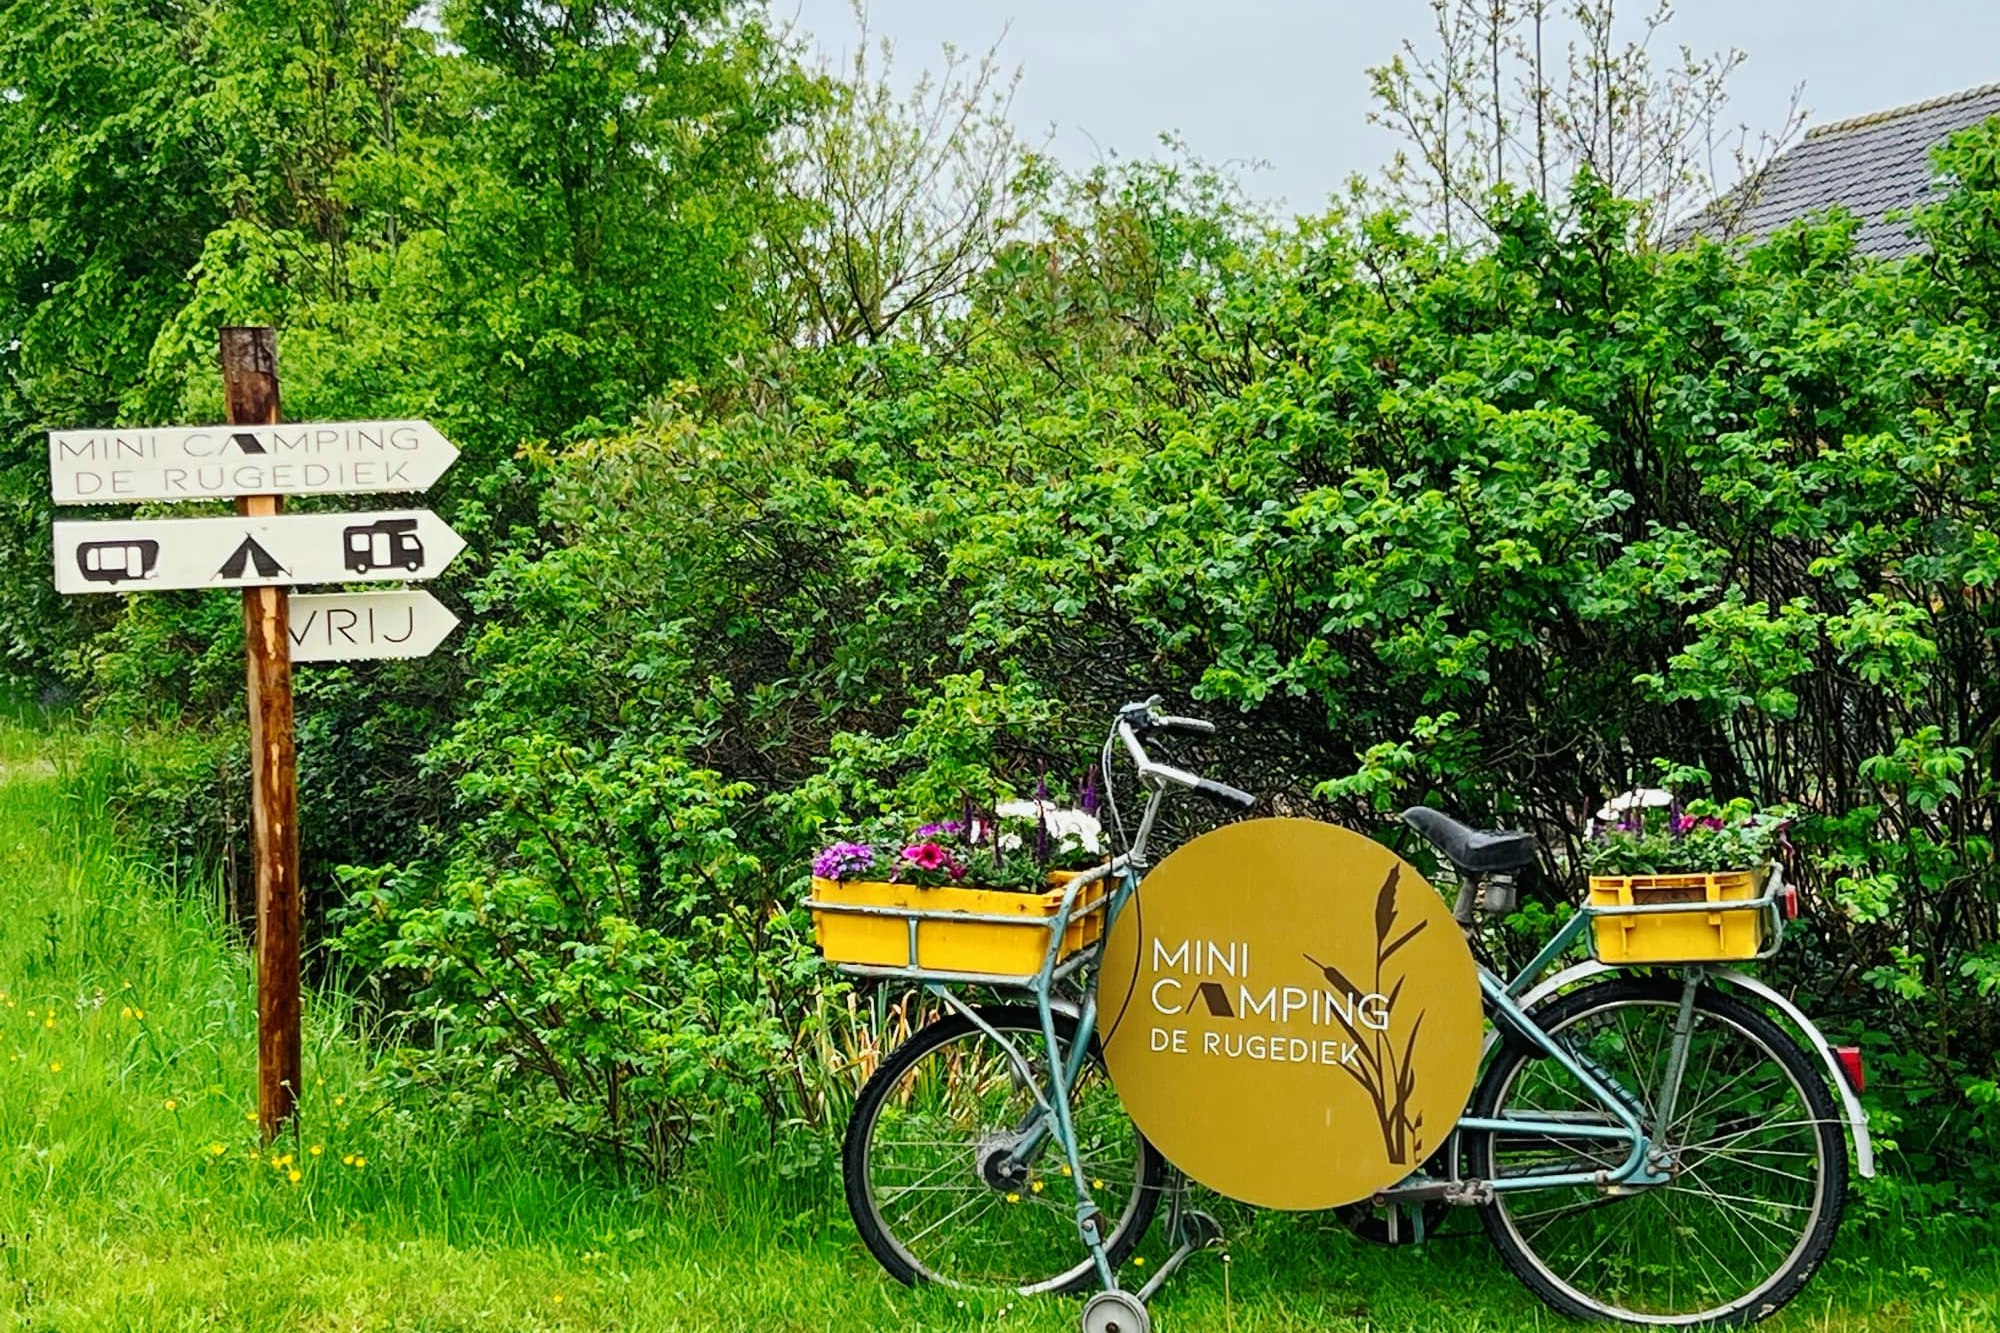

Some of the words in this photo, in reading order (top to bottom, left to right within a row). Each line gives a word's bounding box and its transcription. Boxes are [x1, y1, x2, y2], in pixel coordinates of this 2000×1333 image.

[58, 436, 157, 462] MINI
[183, 427, 420, 458] CAMPING
[75, 470, 134, 495] DE
[164, 461, 411, 491] RUGEDIEK
[288, 605, 414, 647] VRIJ
[1151, 936, 1249, 978] MINI
[1151, 978, 1390, 1032] CAMPING
[1150, 1028, 1188, 1054] DE
[1203, 1032, 1360, 1067] RUGEDIEK
